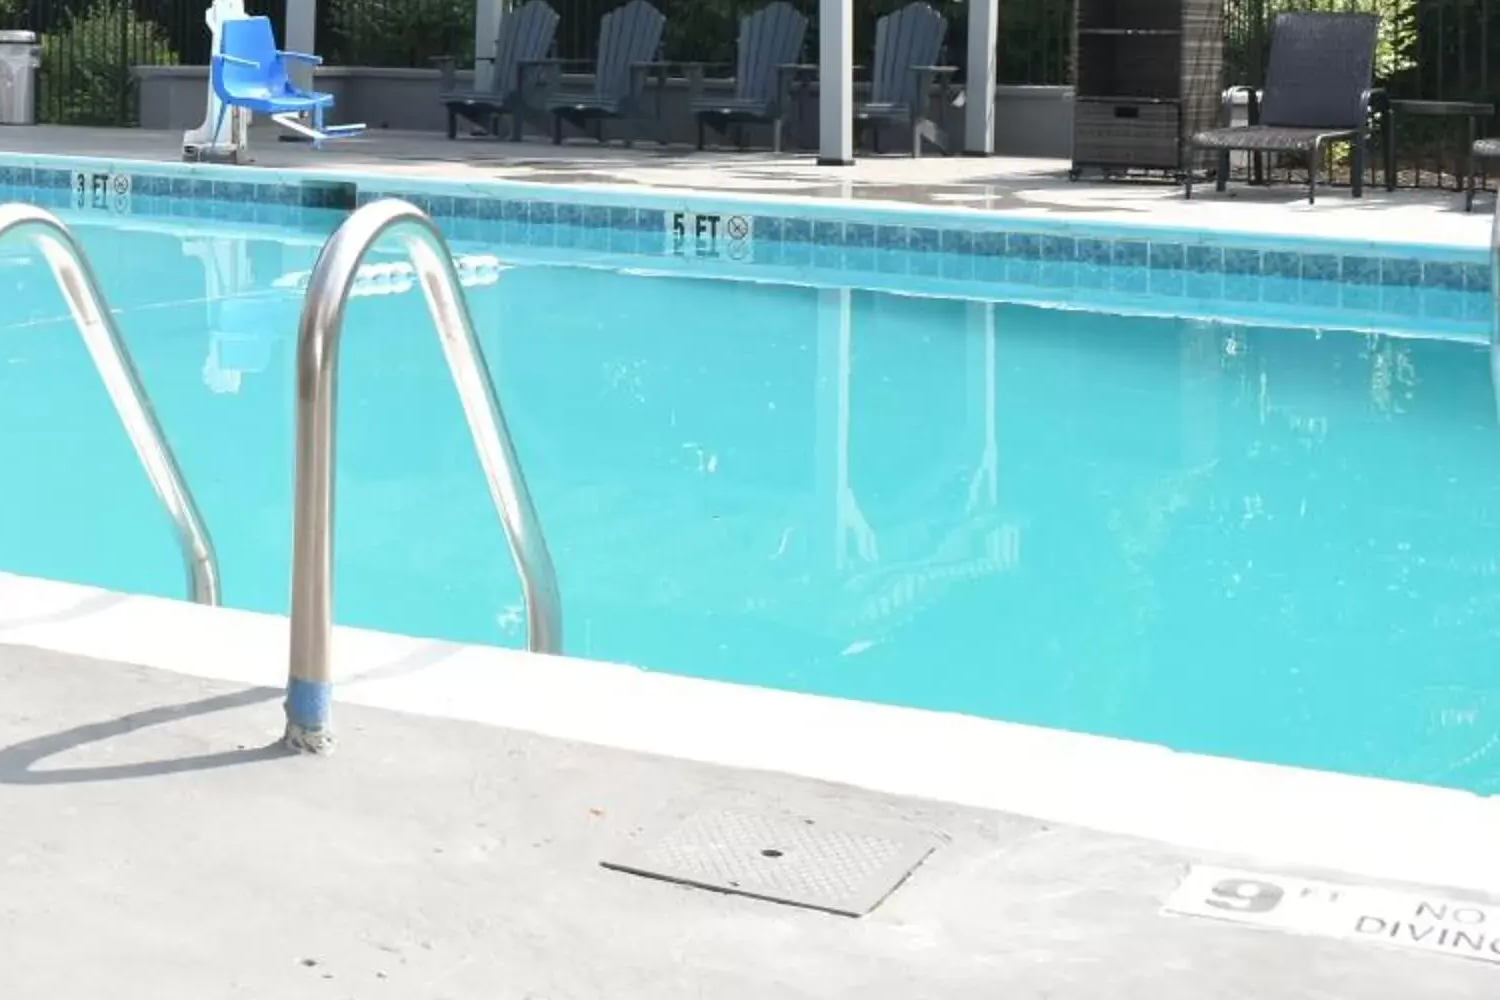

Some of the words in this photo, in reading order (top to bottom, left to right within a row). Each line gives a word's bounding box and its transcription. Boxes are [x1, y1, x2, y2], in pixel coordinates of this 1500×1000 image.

[77, 173, 85, 194] 3
[93, 174, 109, 194] FT
[673, 213, 685, 236] 5
[696, 215, 720, 238] FT
[1204, 877, 1284, 914] 9
[1415, 900, 1486, 926] NO
